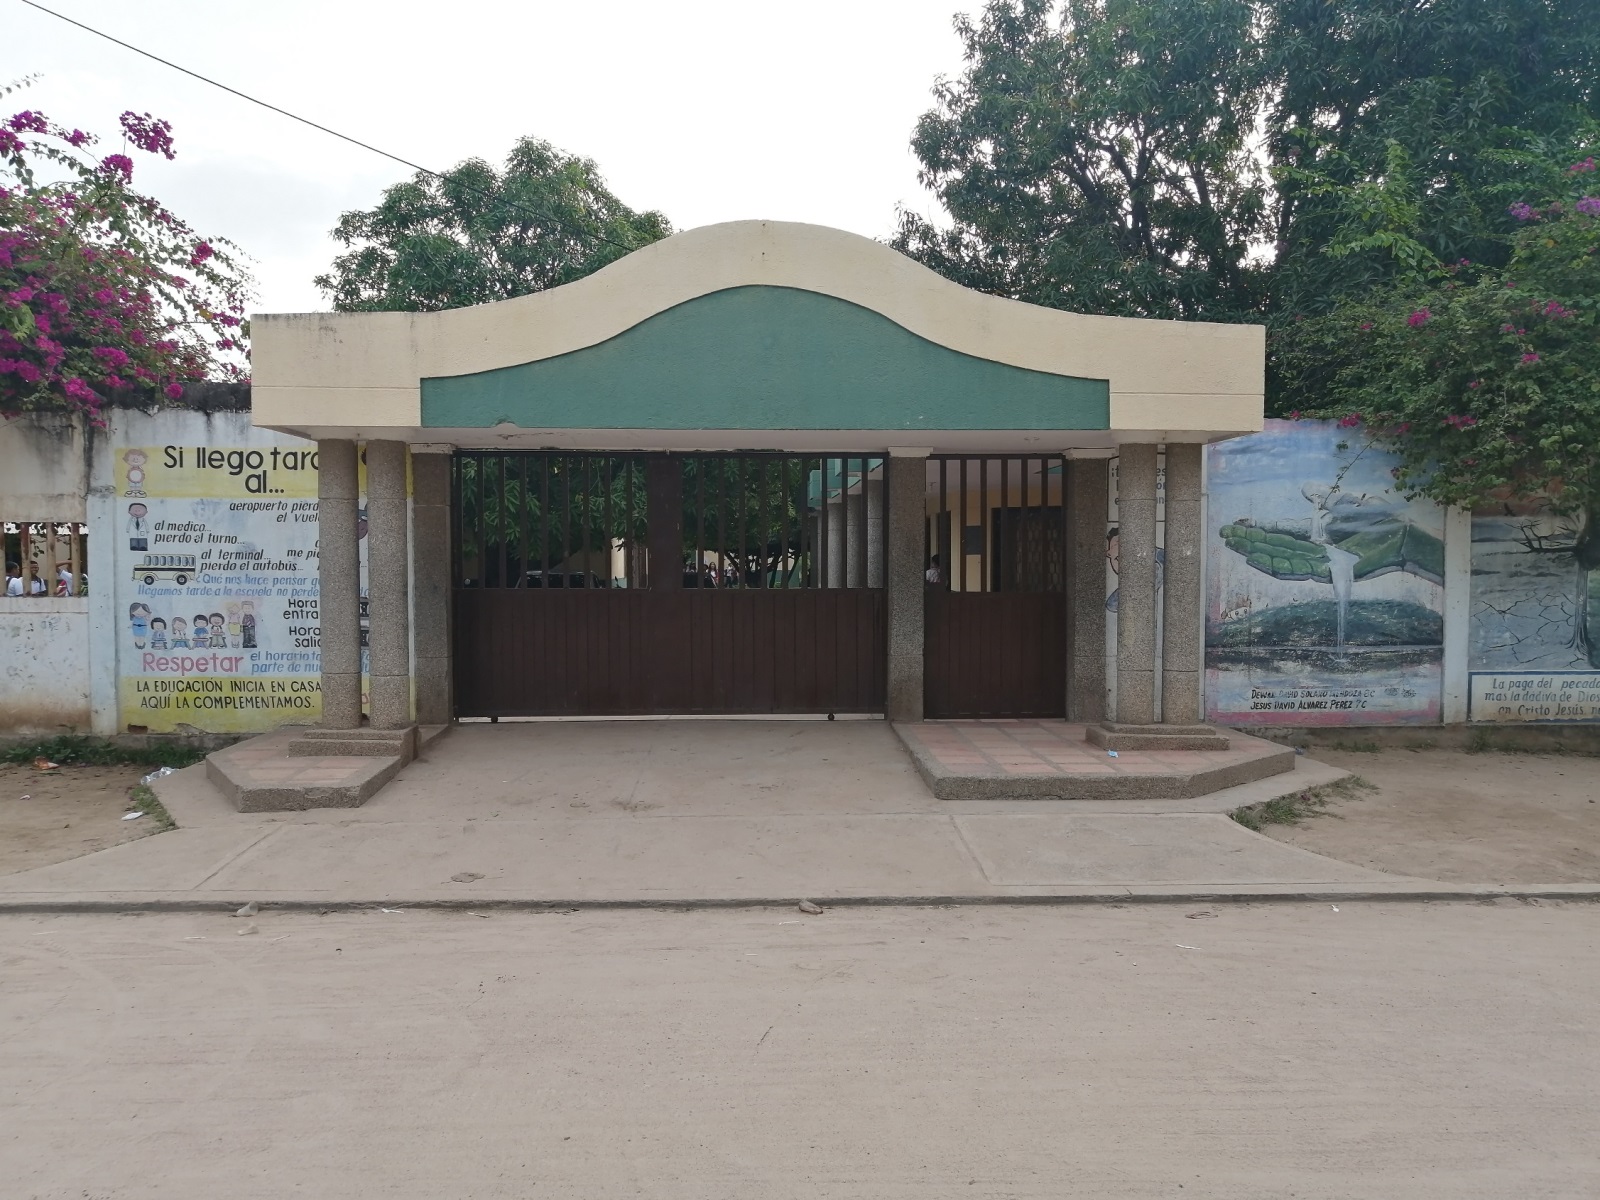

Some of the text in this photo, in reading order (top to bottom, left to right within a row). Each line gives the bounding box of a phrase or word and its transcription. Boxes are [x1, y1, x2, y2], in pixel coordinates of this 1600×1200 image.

[163, 445, 184, 469] Si
[196, 447, 264, 476] llego
[244, 470, 285, 494] al...
[229, 500, 288, 513] aeropuerto
[276, 512, 288, 523] el
[154, 520, 164, 531] al
[154, 533, 191, 545] pierdo
[201, 549, 211, 560] al
[286, 549, 303, 557] me
[200, 560, 236, 573] pierdo
[239, 560, 249, 571] el
[225, 576, 242, 584] nos
[245, 574, 269, 585] hace
[272, 577, 308, 588] pensar
[137, 584, 182, 598] llegamos
[185, 585, 213, 596] tarde
[214, 587, 222, 596] a
[222, 585, 233, 596] la
[235, 586, 272, 597] escuela
[276, 588, 288, 597] no
[288, 599, 318, 609] Hora
[283, 609, 319, 620] entra
[250, 650, 261, 662] el
[265, 650, 310, 662] horario
[142, 651, 244, 676] Respetar
[251, 662, 284, 675] parte
[137, 677, 321, 693] LA EDUCACIÓN INICIA EN CASA
[1492, 678, 1505, 689] La
[1508, 680, 1534, 691] paga
[1536, 677, 1553, 689] del
[140, 694, 315, 709] AQUÍ LA COMPLEMENTAMOS.
[1484, 692, 1507, 702] mas
[1510, 691, 1520, 702] la
[1559, 691, 1572, 702] de
[1250, 701, 1272, 710] JESUS
[1274, 701, 1296, 710] DAVID
[1329, 700, 1353, 710] PEREZ
[1517, 704, 1550, 717] Cristo
[1555, 703, 1584, 716] Jesús
